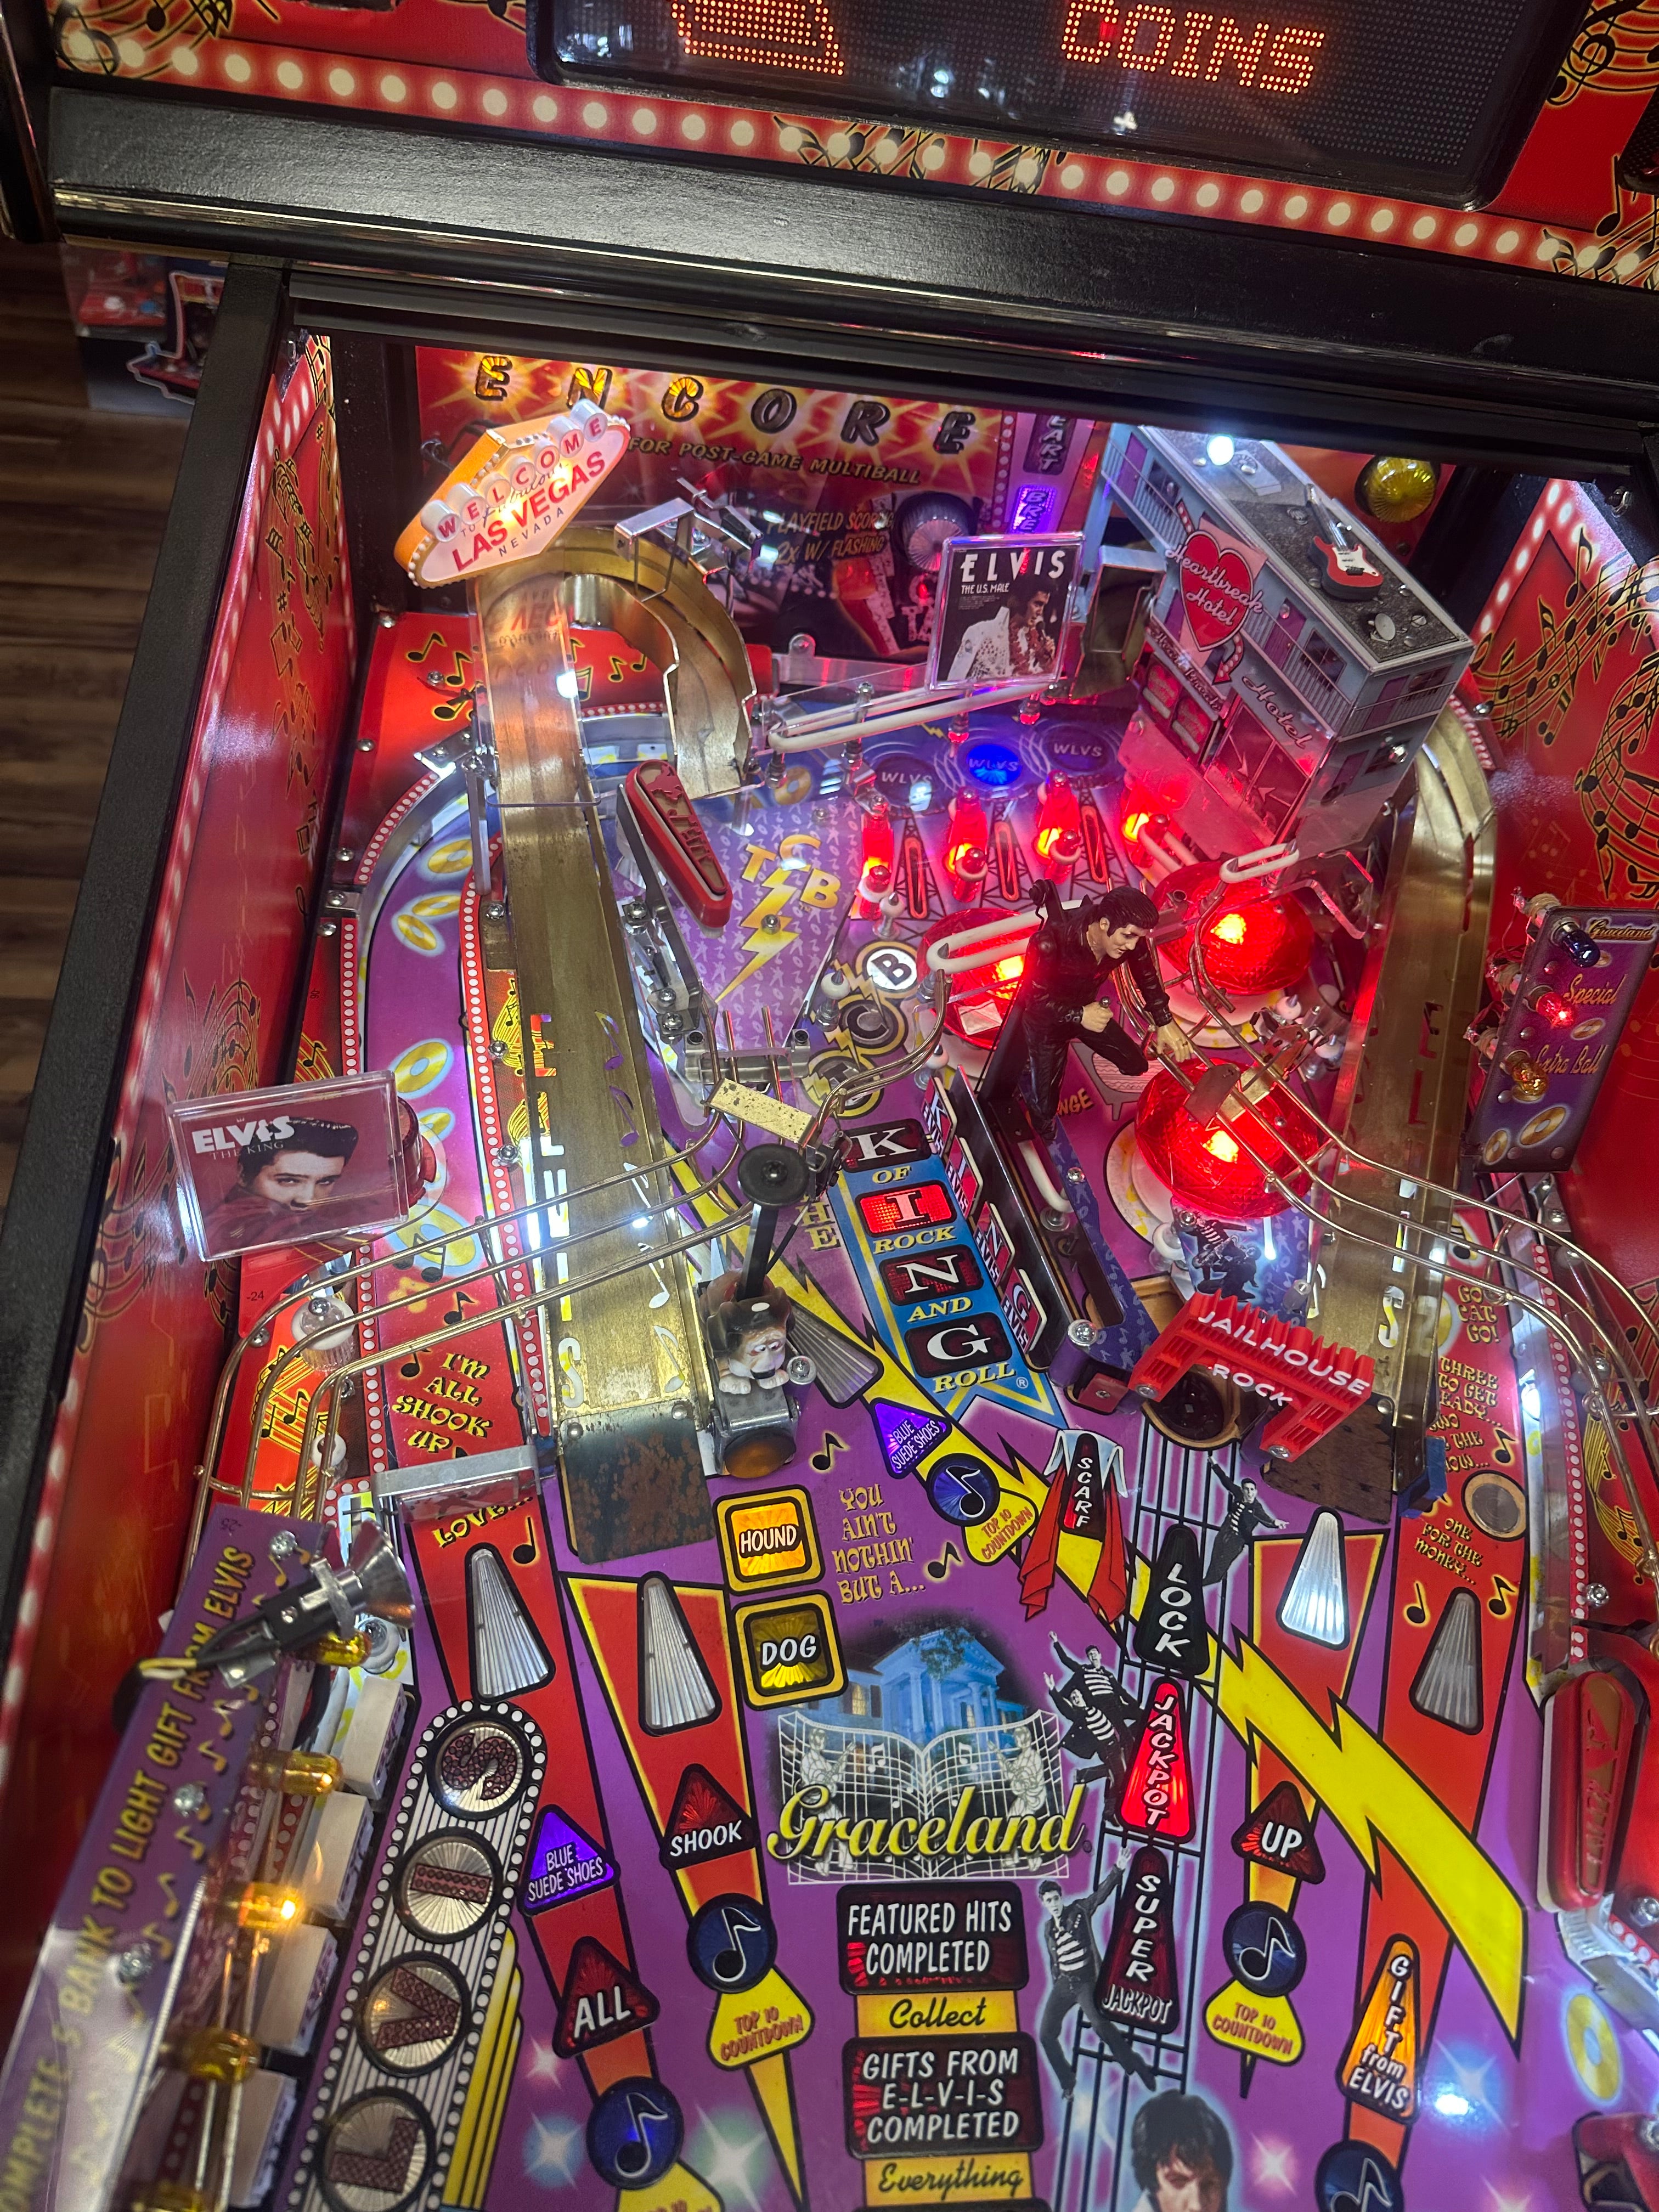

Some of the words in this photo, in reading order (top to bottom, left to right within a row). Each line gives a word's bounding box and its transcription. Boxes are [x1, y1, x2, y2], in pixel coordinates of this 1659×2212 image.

[1062, 0, 1324, 94] COINS
[629, 437, 671, 455] FOR
[679, 443, 803, 470] POST-GAME
[809, 457, 920, 484] MULTIBALL
[1040, 415, 1066, 470] EART
[438, 417, 602, 539] WELCOME
[452, 520, 508, 572] LAS
[511, 451, 606, 529] VEGAS
[498, 507, 564, 557] NEVADA
[831, 535, 885, 558] FLASHING
[960, 550, 1067, 583] ELVIS
[1165, 544, 1264, 614] Heartbreak
[961, 584, 975, 595] THE
[990, 583, 1010, 593] MALE
[1186, 588, 1239, 626] Hotel
[1242, 676, 1313, 749] Hotel
[882, 771, 932, 786] WLVS
[969, 757, 1019, 772] WLVS
[1053, 742, 1103, 757] WLVS
[1562, 974, 1628, 1007] Special
[191, 1116, 295, 1154] ELVIS
[247, 1141, 284, 1155] KING
[872, 1165, 911, 1184] OF
[873, 1226, 956, 1254] ROCK
[906, 1295, 974, 1323] AND
[1457, 1304, 1498, 1323] CAT
[1466, 1323, 1501, 1345] GO!
[1197, 1311, 1371, 1395] JAILHOUSE
[423, 1376, 483, 1407] ALL
[932, 1362, 1017, 1393] ROLL
[1212, 1363, 1294, 1407] ROCK
[1440, 1356, 1499, 1391] THREE
[1440, 1391, 1503, 1427] EADY...
[1464, 1383, 1498, 1407] GET
[392, 1394, 493, 1438] SHOOK
[892, 1420, 915, 1446] BLUE
[913, 1419, 940, 1449] SHOES
[408, 1429, 453, 1453] UP
[891, 1438, 918, 1470] SUEDE
[1449, 1431, 1485, 1450] THE
[839, 1483, 885, 1512] YOU
[1073, 1457, 1094, 1528] SCARF
[740, 1525, 798, 1553] HOUND
[841, 1511, 898, 1542] AIN'T
[980, 1516, 1001, 1538] TOP
[980, 1506, 1034, 1561] COUNTDOWN
[1422, 1522, 1452, 1549] FOR
[1453, 1540, 1483, 1567] THE
[1444, 1517, 1474, 1542] ONE
[831, 1537, 914, 1576] NOTHIN'
[204, 1545, 255, 1621] ELVIS
[836, 1577, 883, 1605] BUT
[889, 1570, 927, 1595] A...
[1154, 1562, 1192, 1658] LOCK
[761, 1634, 817, 1666] DOG
[146, 1702, 193, 1768] GIFT
[1143, 1696, 1176, 1826] JACKPOT
[110, 1769, 166, 1861] LIGHT
[767, 1779, 1085, 1859] Graceland
[670, 1820, 742, 1858] SHOOK
[1261, 1821, 1303, 1859] UP
[546, 1844, 574, 1872] BLUE
[566, 1856, 605, 1888] SHOES
[90, 1866, 136, 1911] TO
[527, 1870, 566, 1903] SUEDE
[848, 1902, 956, 1936] FEATURED
[966, 1899, 1012, 1933] HITS
[1125, 1874, 1161, 1983] SUPER
[866, 1939, 990, 1976] COMPLETED
[573, 1985, 632, 2039] ALL
[733, 2011, 761, 2035] TOP
[762, 2005, 780, 2023] 10
[889, 1996, 988, 2029] Collect
[1102, 1984, 1173, 2026] JACKPOT
[1234, 2001, 1257, 2023] TOP
[1262, 2016, 1277, 2030] 10
[1378, 1955, 1410, 2055] GIFT
[721, 2014, 804, 2061] COUNTDOWN
[1212, 2014, 1294, 2055] COUNTDOWN
[862, 2050, 935, 2080] GIFTS
[947, 2047, 1019, 2076] FROM
[1361, 2044, 1406, 2079] from
[882, 2078, 1005, 2110] E-L-V-I-S
[1348, 2067, 1410, 2110] ELVIS
[866, 2110, 1019, 2145] COMPLETED
[879, 2157, 1024, 2201] Everything
